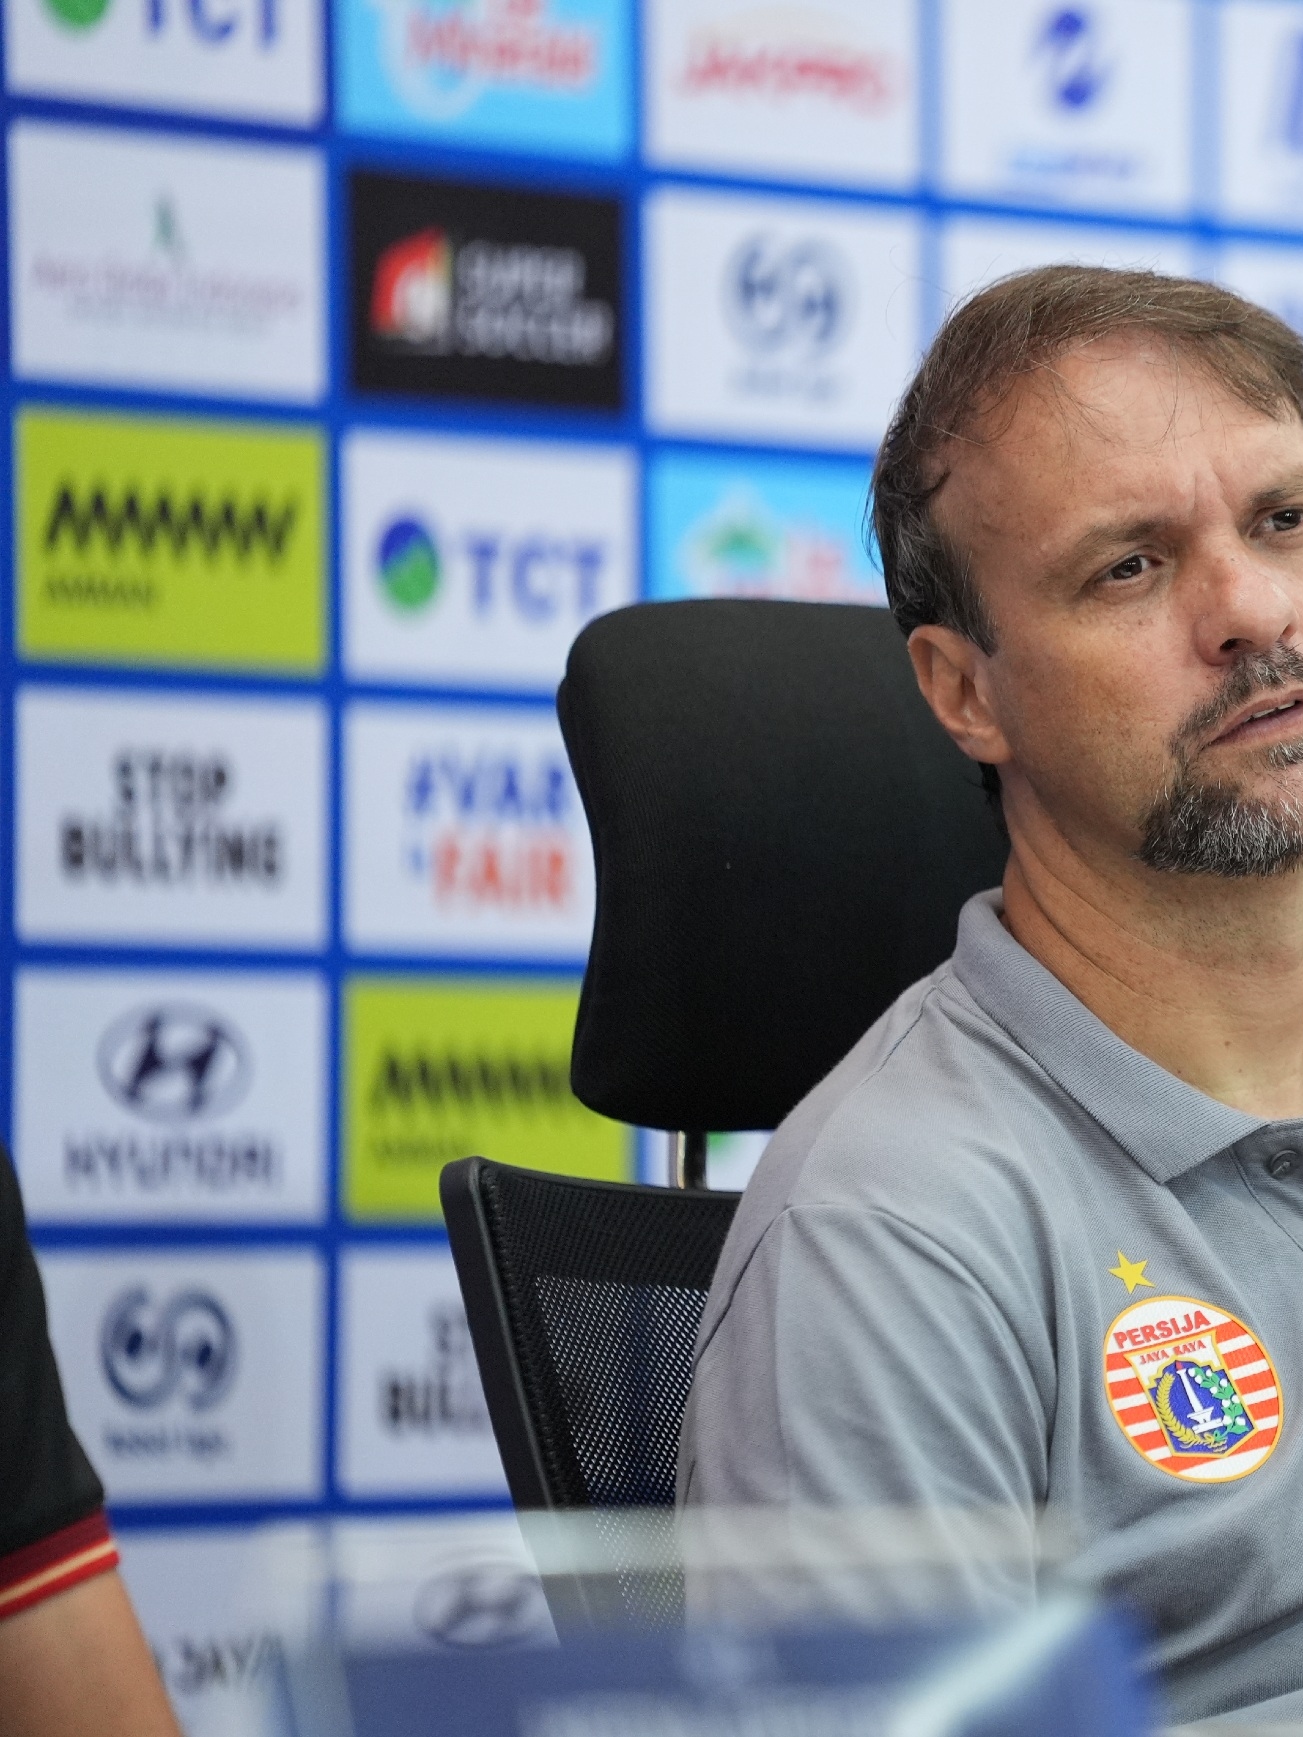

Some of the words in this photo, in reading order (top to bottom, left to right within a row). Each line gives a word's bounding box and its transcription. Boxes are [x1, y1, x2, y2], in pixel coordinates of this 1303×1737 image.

[462, 532, 608, 622] TCT
[115, 748, 232, 806] STOP
[408, 748, 576, 824] #VAR
[64, 815, 283, 884] BULLYING
[432, 828, 576, 911] FAIR
[1113, 1310, 1211, 1349] PERSIJA
[1140, 1350, 1170, 1365] JAYA
